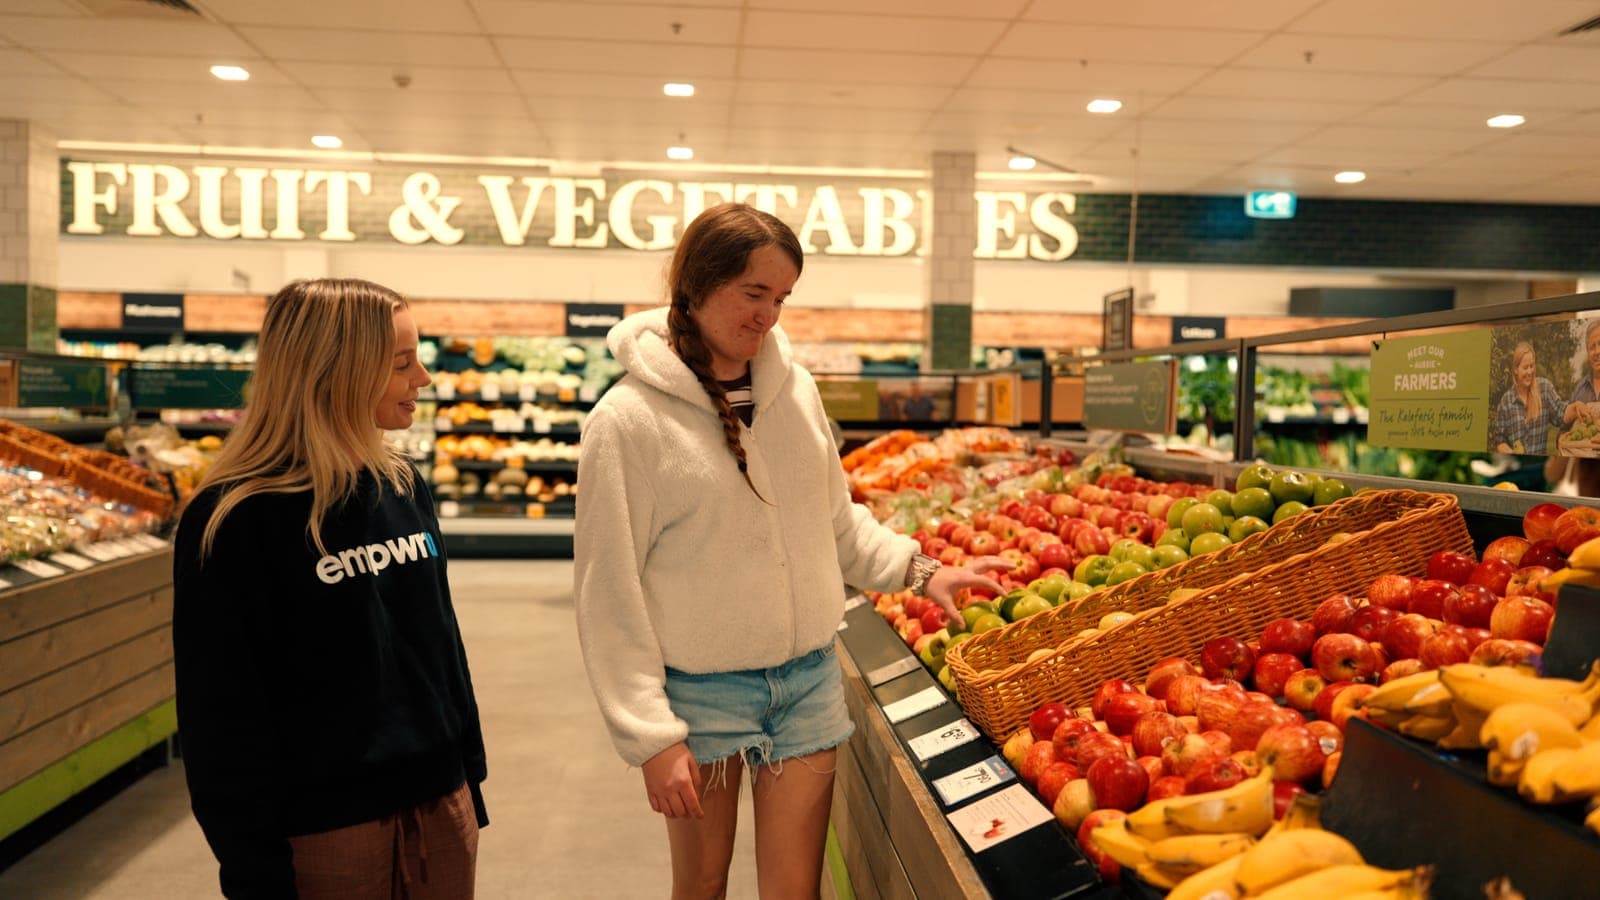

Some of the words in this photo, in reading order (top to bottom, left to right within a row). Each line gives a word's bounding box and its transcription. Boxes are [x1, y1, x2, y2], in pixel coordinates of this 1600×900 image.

[67, 161, 372, 241] FRUIT
[388, 172, 465, 246] &
[478, 174, 1079, 262] VEGTABES
[1407, 345, 1427, 361] MEET
[1428, 344, 1445, 359] OUR
[1394, 372, 1457, 392] FARMERS
[1379, 410, 1394, 424] The
[1439, 405, 1473, 431] family
